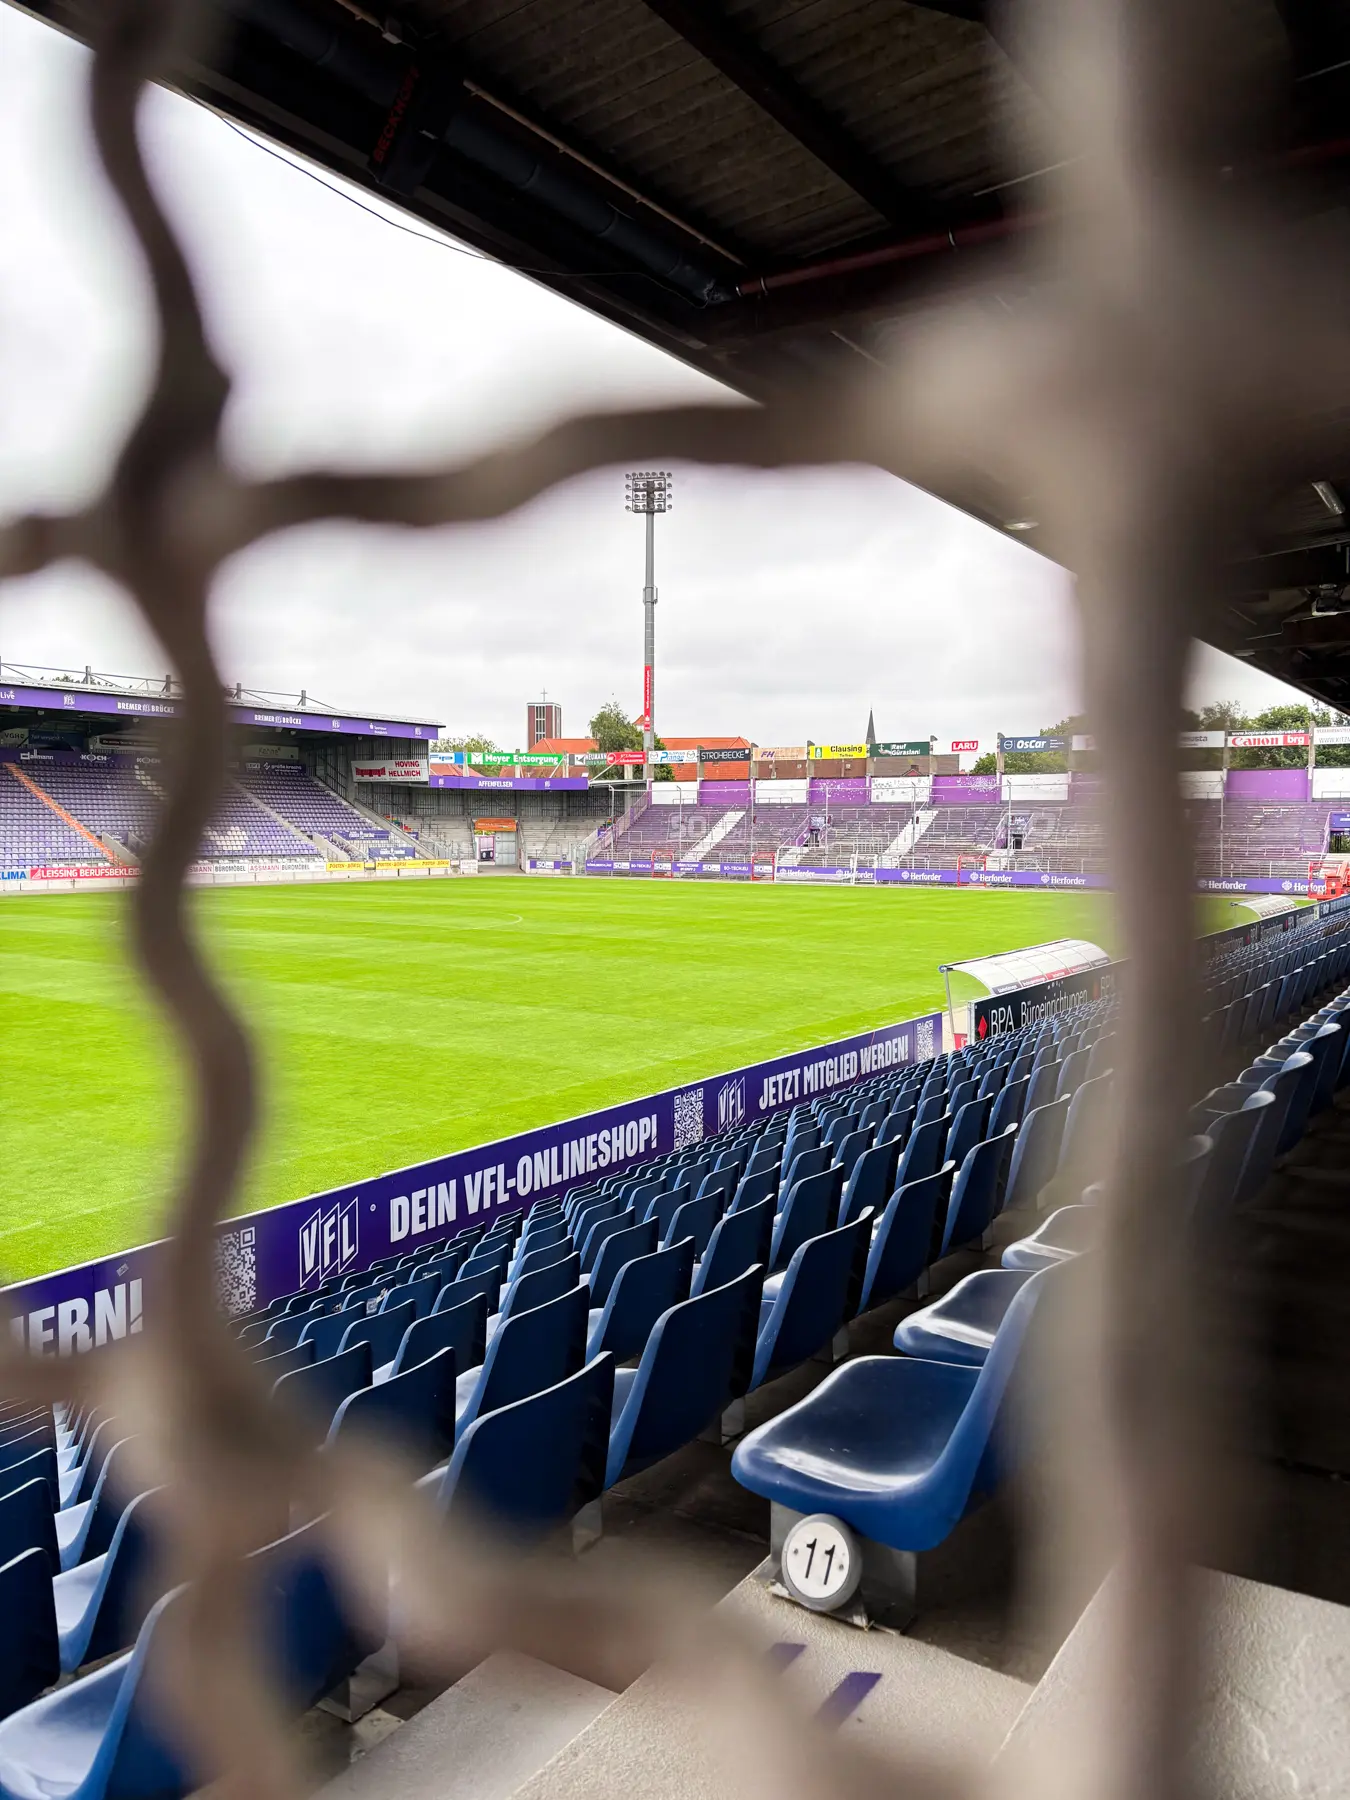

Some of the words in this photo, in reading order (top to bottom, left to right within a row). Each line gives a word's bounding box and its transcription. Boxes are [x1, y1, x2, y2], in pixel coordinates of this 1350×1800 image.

[117, 702, 142, 711] BREMER
[151, 703, 175, 714] BRÜCKE
[254, 714, 275, 723] BREMER
[282, 716, 302, 725] BRÜCKE
[952, 742, 977, 750] LARU
[1016, 739, 1047, 749] OsCar
[1231, 736, 1279, 747] Canon
[1287, 735, 1305, 745] brg
[830, 745, 863, 753] Clausing
[485, 755, 511, 764] Meyer
[513, 755, 558, 765] Entsorgung
[701, 751, 745, 760] STROHBECKE
[478, 780, 513, 788] AFFENFELSEN
[214, 864, 246, 873] BÜROMÖBEL
[249, 863, 280, 872] ASSMANN
[281, 862, 310, 871] BÜROMÖBEL
[42, 868, 78, 878] LEISSING
[910, 872, 942, 881] Herforder
[979, 873, 1012, 883] Herforder
[1051, 875, 1087, 885] Herforder
[1208, 880, 1248, 890] Herforder
[990, 1004, 1015, 1038] BPA
[759, 1068, 801, 1111] JETZT
[803, 1050, 858, 1094] MITGLIED
[860, 1034, 909, 1076] WERDEN!
[390, 1178, 457, 1243] DEIN
[463, 1113, 659, 1216] VFL-ONLINESHOP!
[805, 1537, 836, 1586] 11
